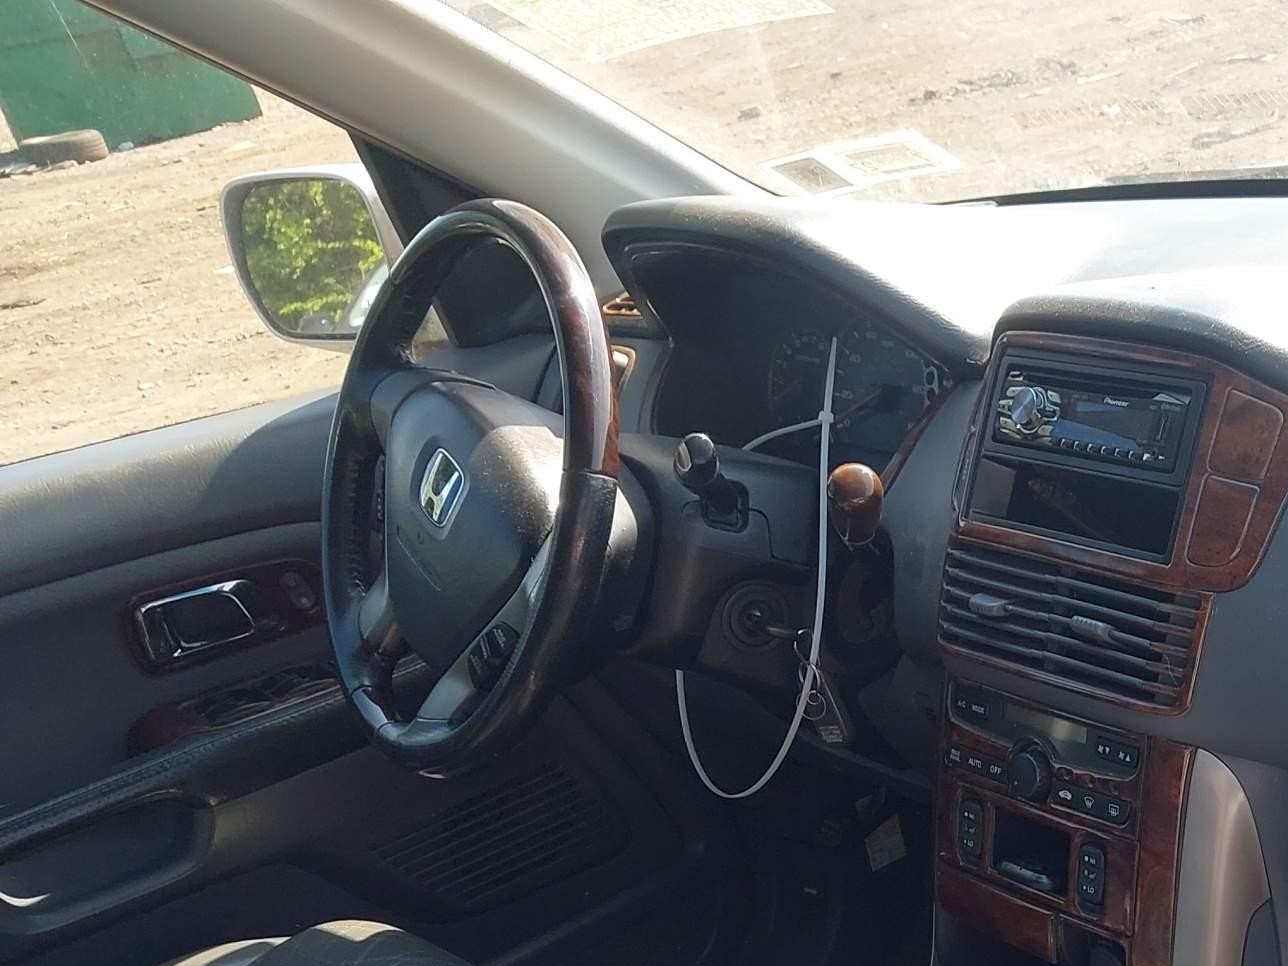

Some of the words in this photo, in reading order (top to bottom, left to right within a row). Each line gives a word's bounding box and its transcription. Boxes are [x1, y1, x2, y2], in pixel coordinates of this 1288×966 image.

[1103, 397, 1129, 408] Pioneer
[968, 758, 982, 769] AUTO
[989, 765, 1002, 774] OFF
